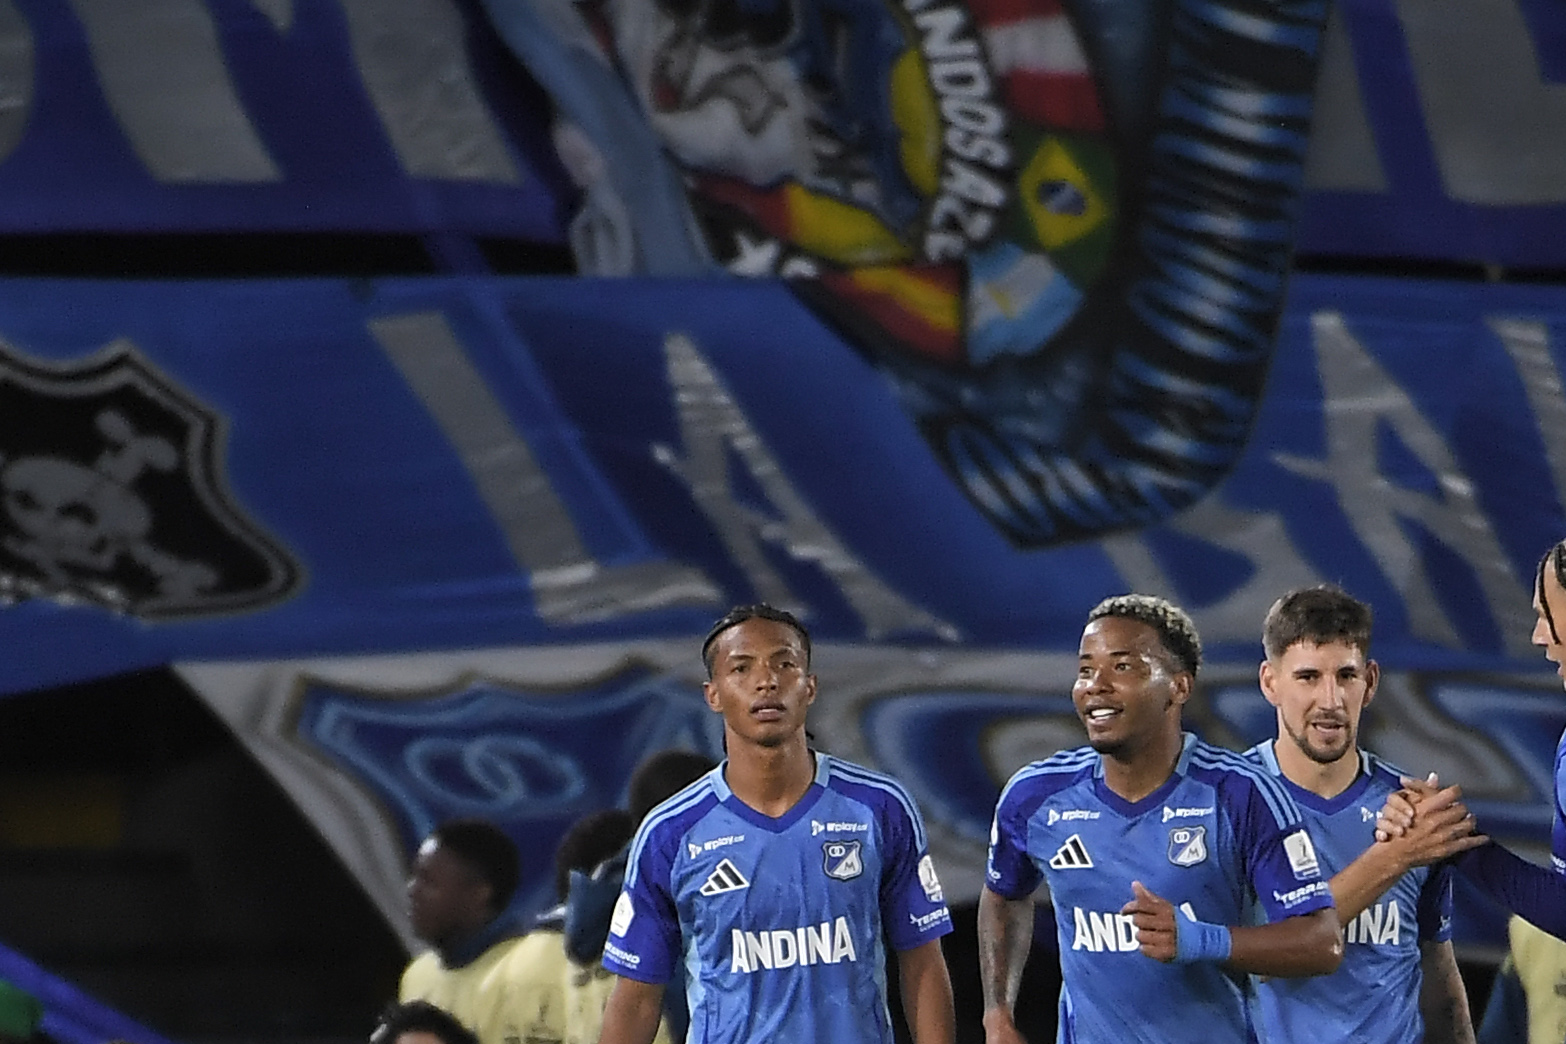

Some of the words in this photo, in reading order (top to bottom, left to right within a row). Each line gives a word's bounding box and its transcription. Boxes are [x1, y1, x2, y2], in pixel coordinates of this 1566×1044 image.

[905, 0, 1010, 167] NDOS
[366, 311, 960, 645] LA
[731, 916, 856, 974] ANDINA
[1342, 900, 1400, 946] INA
